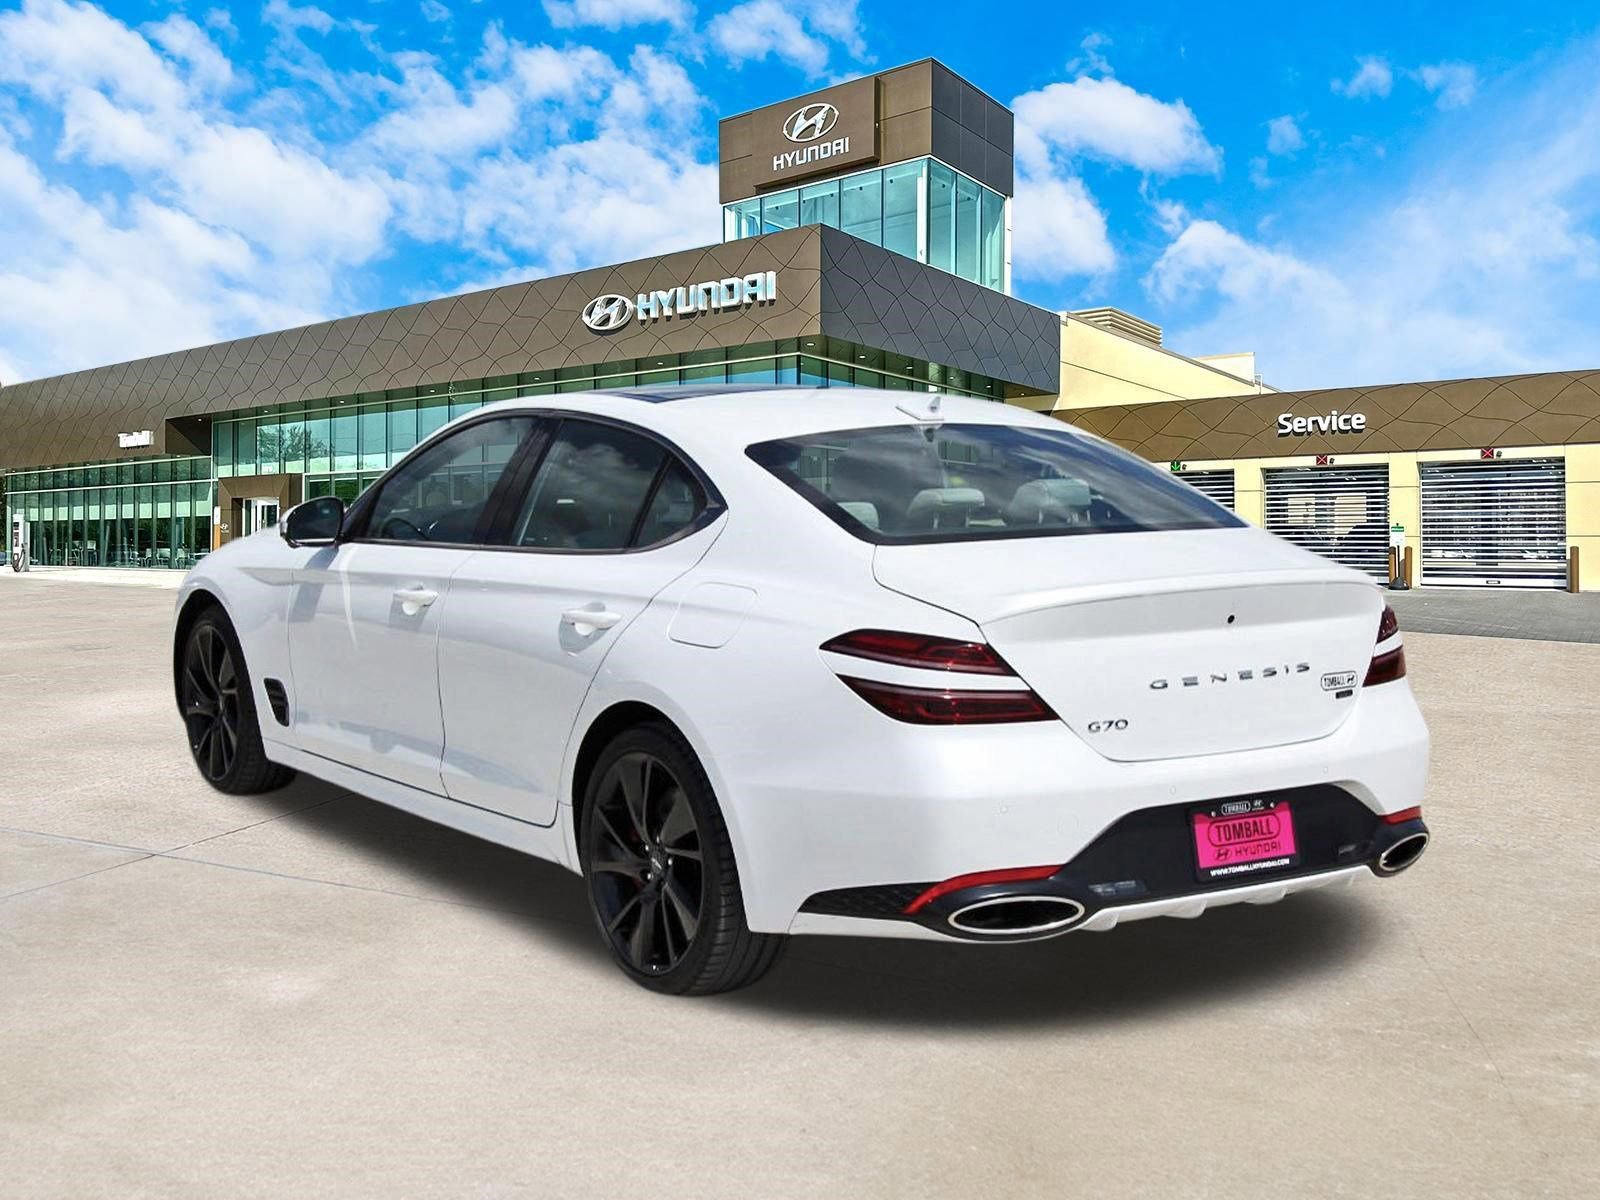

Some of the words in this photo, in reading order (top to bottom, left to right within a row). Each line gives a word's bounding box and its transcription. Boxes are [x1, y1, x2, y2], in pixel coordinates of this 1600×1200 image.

[773, 137, 850, 171] HYUNDAI
[637, 271, 777, 321] HYUNDAI
[1277, 411, 1367, 435] Service
[1149, 662, 1311, 690] GENESIS
[1087, 719, 1129, 733] G70
[1214, 818, 1274, 843] TOMBALL
[1234, 841, 1281, 857] HYUNDAI
